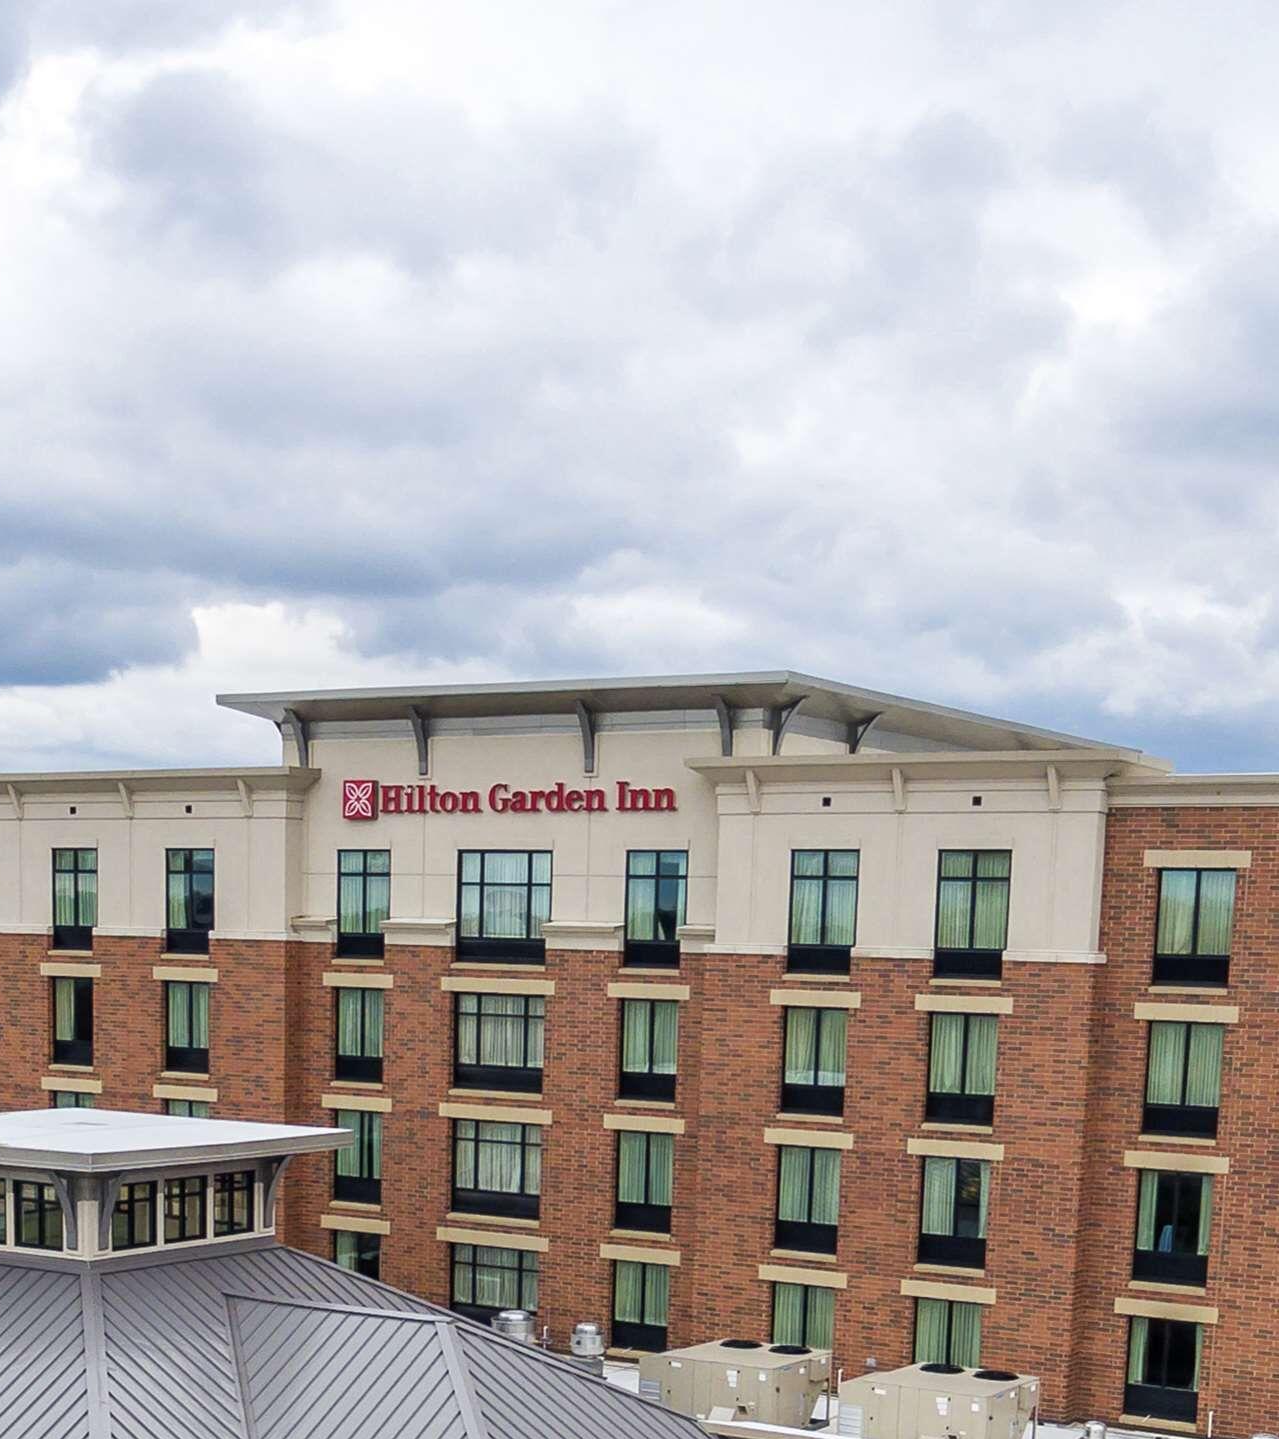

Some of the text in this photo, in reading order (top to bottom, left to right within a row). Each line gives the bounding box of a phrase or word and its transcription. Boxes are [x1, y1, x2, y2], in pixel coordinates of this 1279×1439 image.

[380, 781, 677, 814] Hilton Garden Inn
